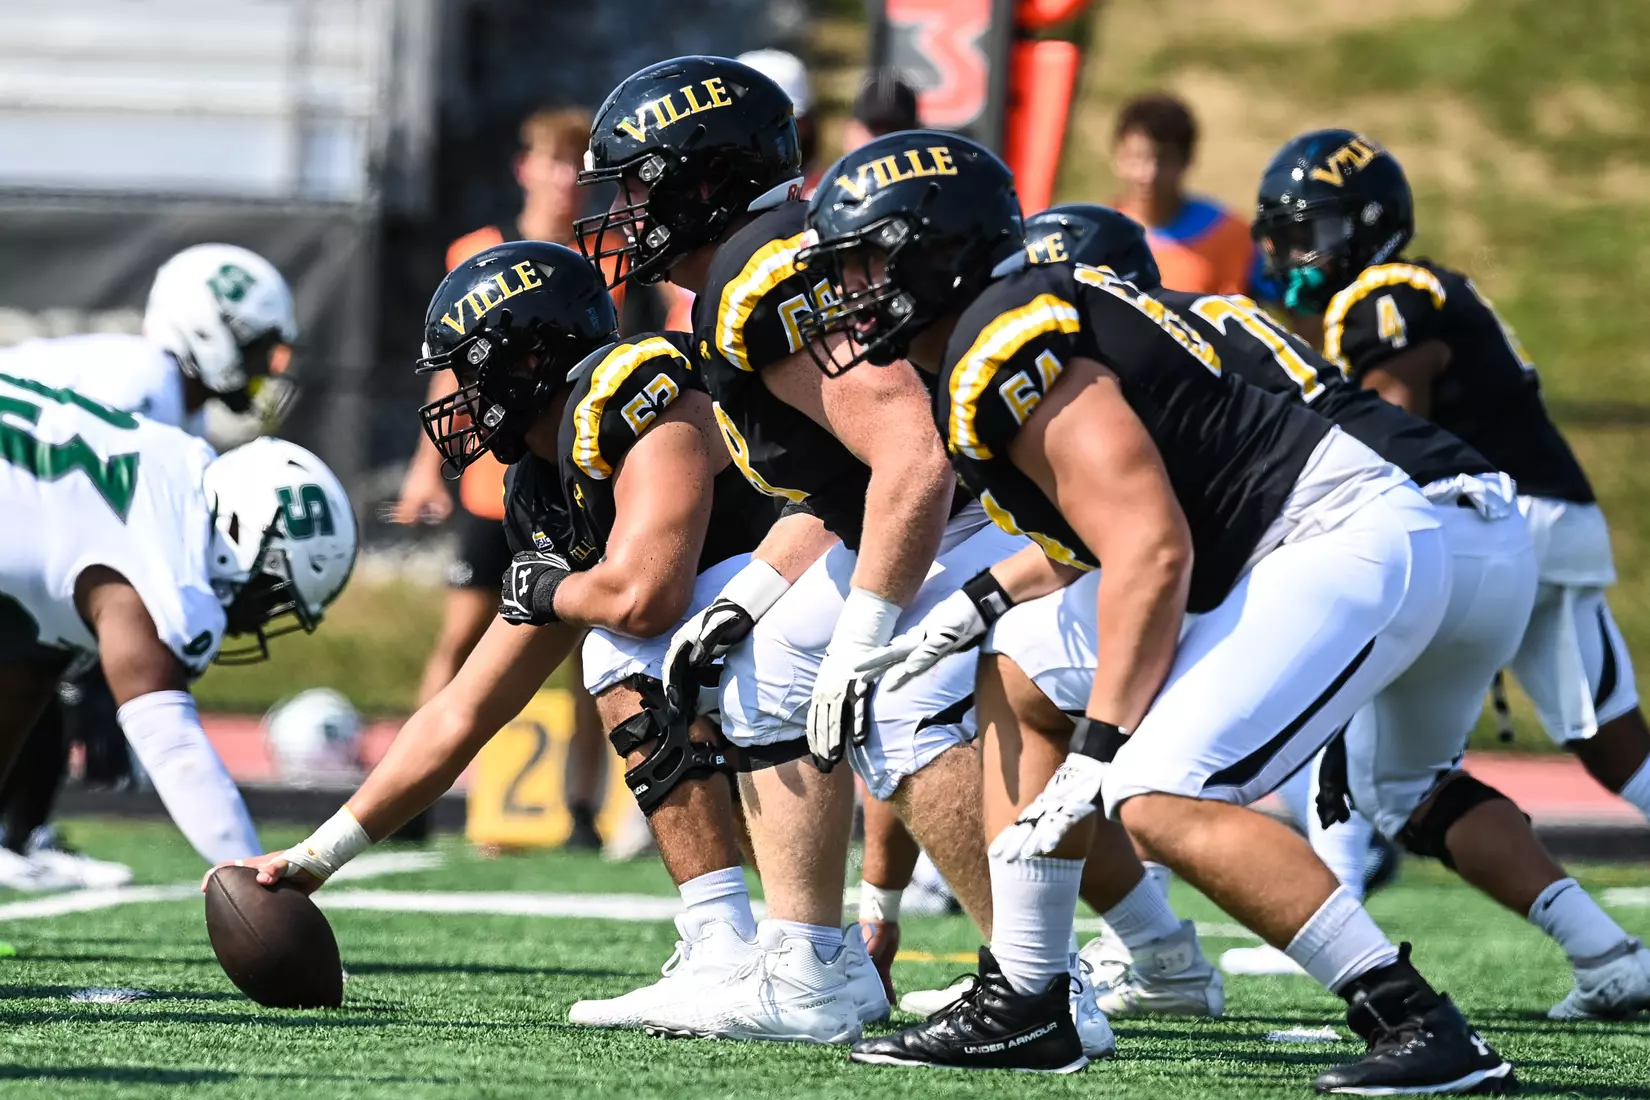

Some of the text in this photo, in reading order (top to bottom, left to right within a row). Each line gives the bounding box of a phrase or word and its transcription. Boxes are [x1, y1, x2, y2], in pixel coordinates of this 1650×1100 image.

[885, 0, 992, 130] 3
[616, 77, 732, 143] VILLE
[833, 147, 958, 200] VILLE
[441, 260, 542, 334] VILLE
[1376, 294, 1408, 349] 4
[502, 719, 547, 816] 2
[964, 1022, 1057, 1054] UNDER ARMOUR
